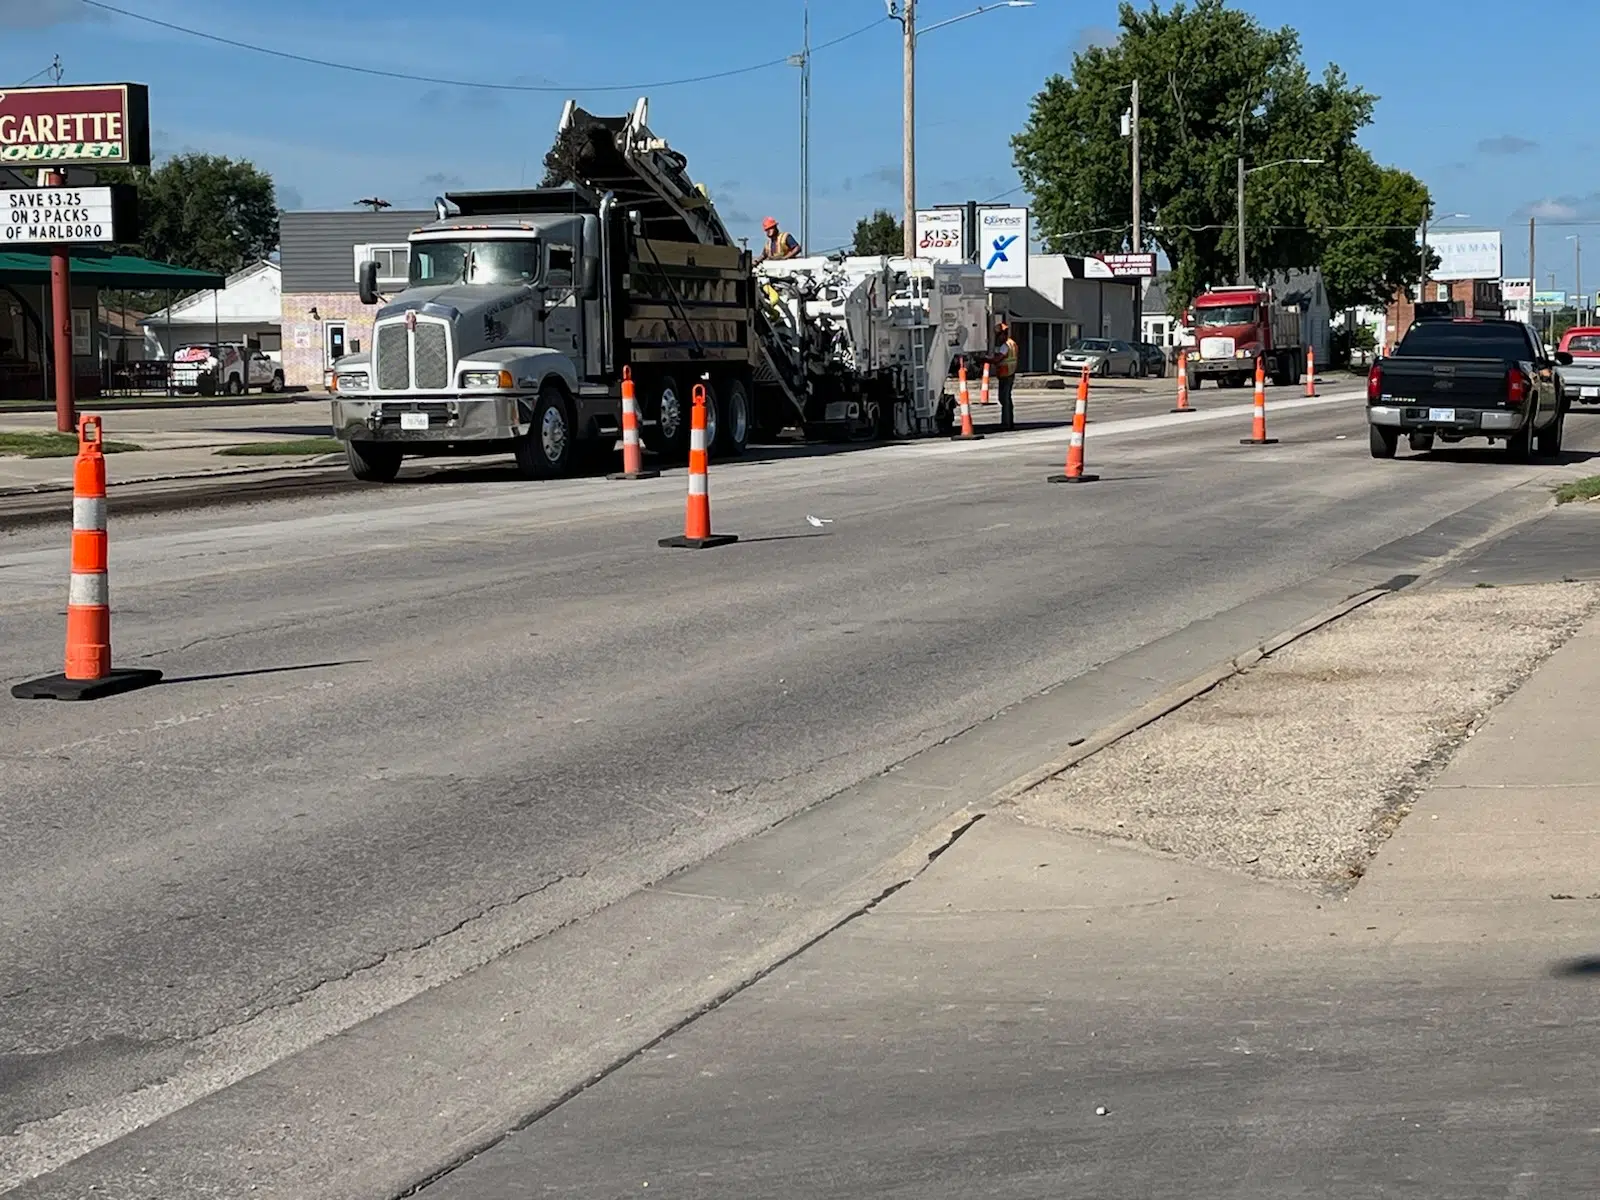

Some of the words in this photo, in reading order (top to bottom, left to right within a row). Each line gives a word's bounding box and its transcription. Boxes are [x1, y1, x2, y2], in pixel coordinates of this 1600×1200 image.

[0, 112, 122, 143] GARETTE
[2, 142, 120, 160] OUTLET
[10, 193, 44, 207] SAVE
[48, 192, 82, 206] $3.25
[12, 210, 28, 223] ON
[33, 209, 40, 223] 3
[45, 208, 89, 222] PACKS
[6, 226, 22, 239] OF
[29, 224, 102, 239] MARLBORO
[924, 229, 959, 240] KISS
[1437, 243, 1497, 253] NEWMAN
